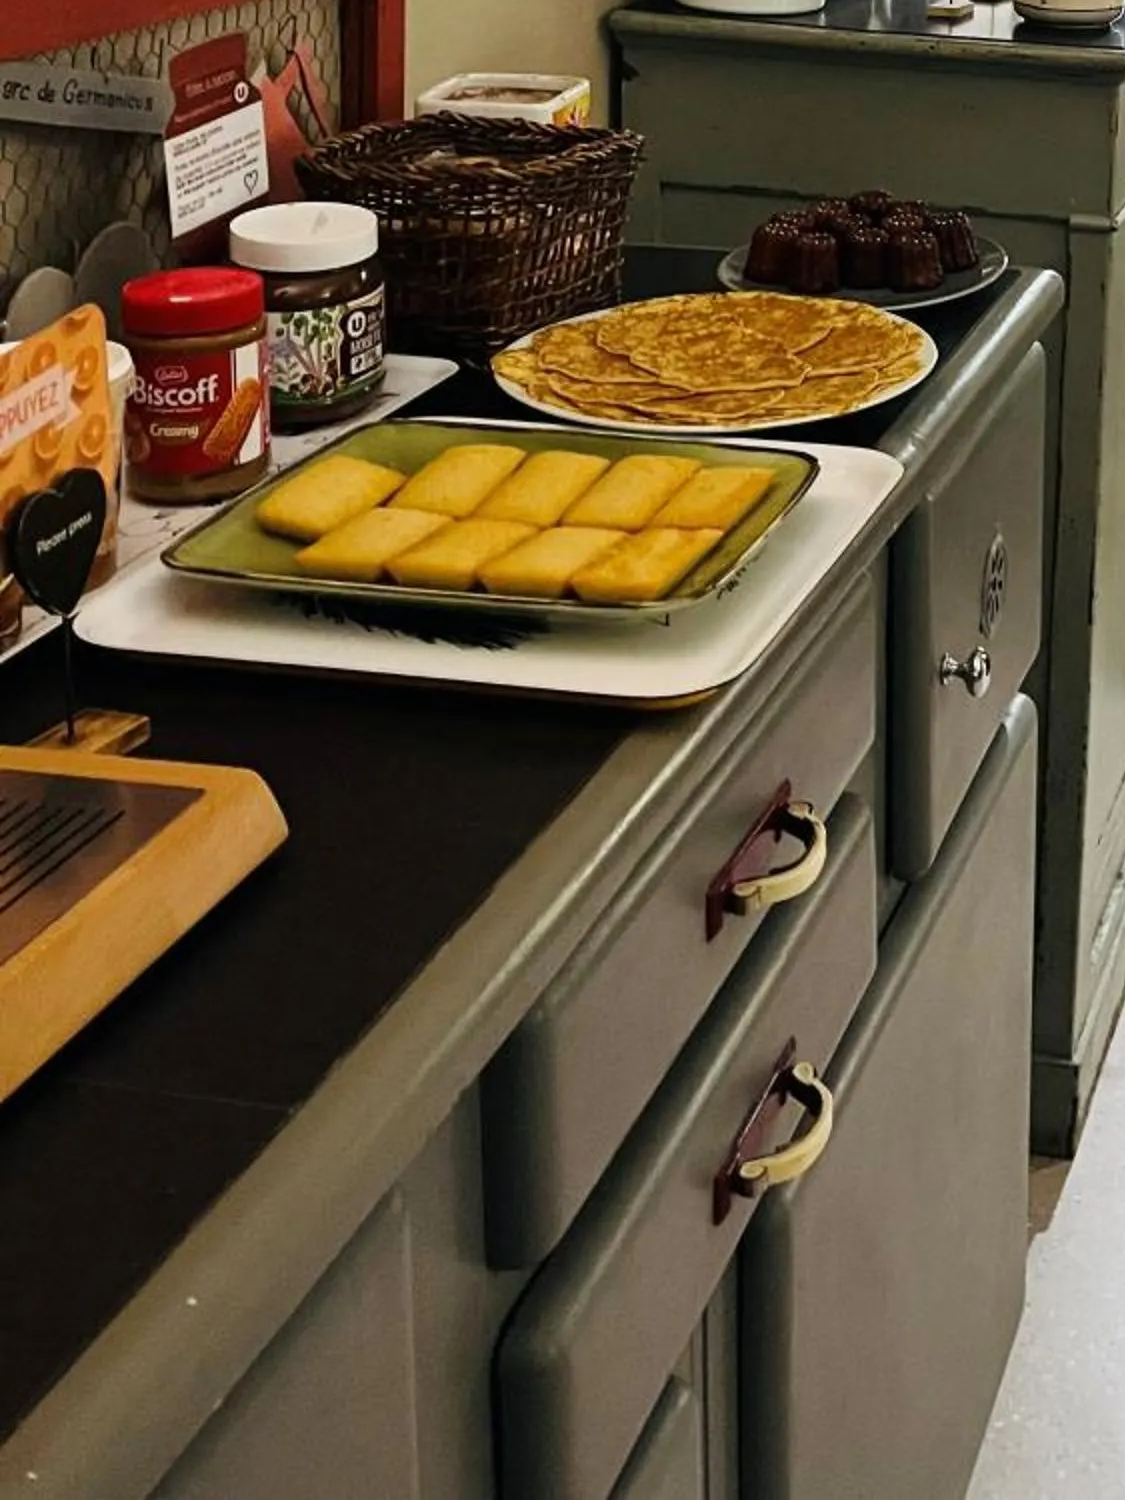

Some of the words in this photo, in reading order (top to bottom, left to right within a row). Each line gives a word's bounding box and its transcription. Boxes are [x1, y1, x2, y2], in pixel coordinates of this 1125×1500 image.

[37, 80, 55, 103] de
[133, 373, 219, 406] Biscoff
[150, 422, 199, 440] Creamy
